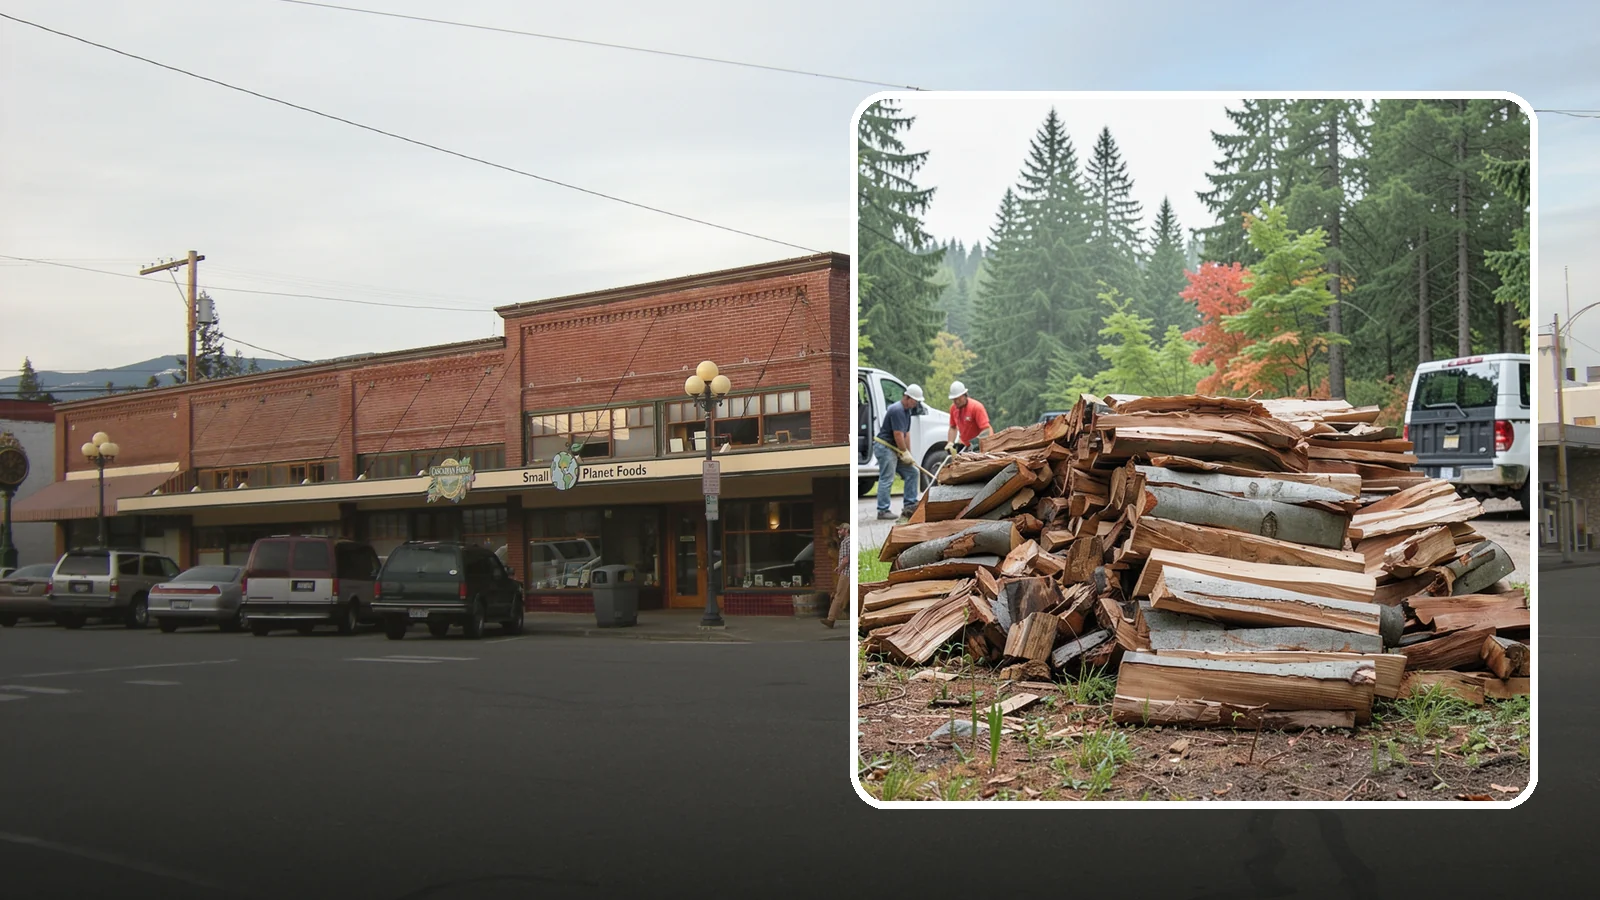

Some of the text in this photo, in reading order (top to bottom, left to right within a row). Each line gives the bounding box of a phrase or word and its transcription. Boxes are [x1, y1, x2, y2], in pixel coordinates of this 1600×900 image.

[522, 464, 647, 483] Small Planet Foods
